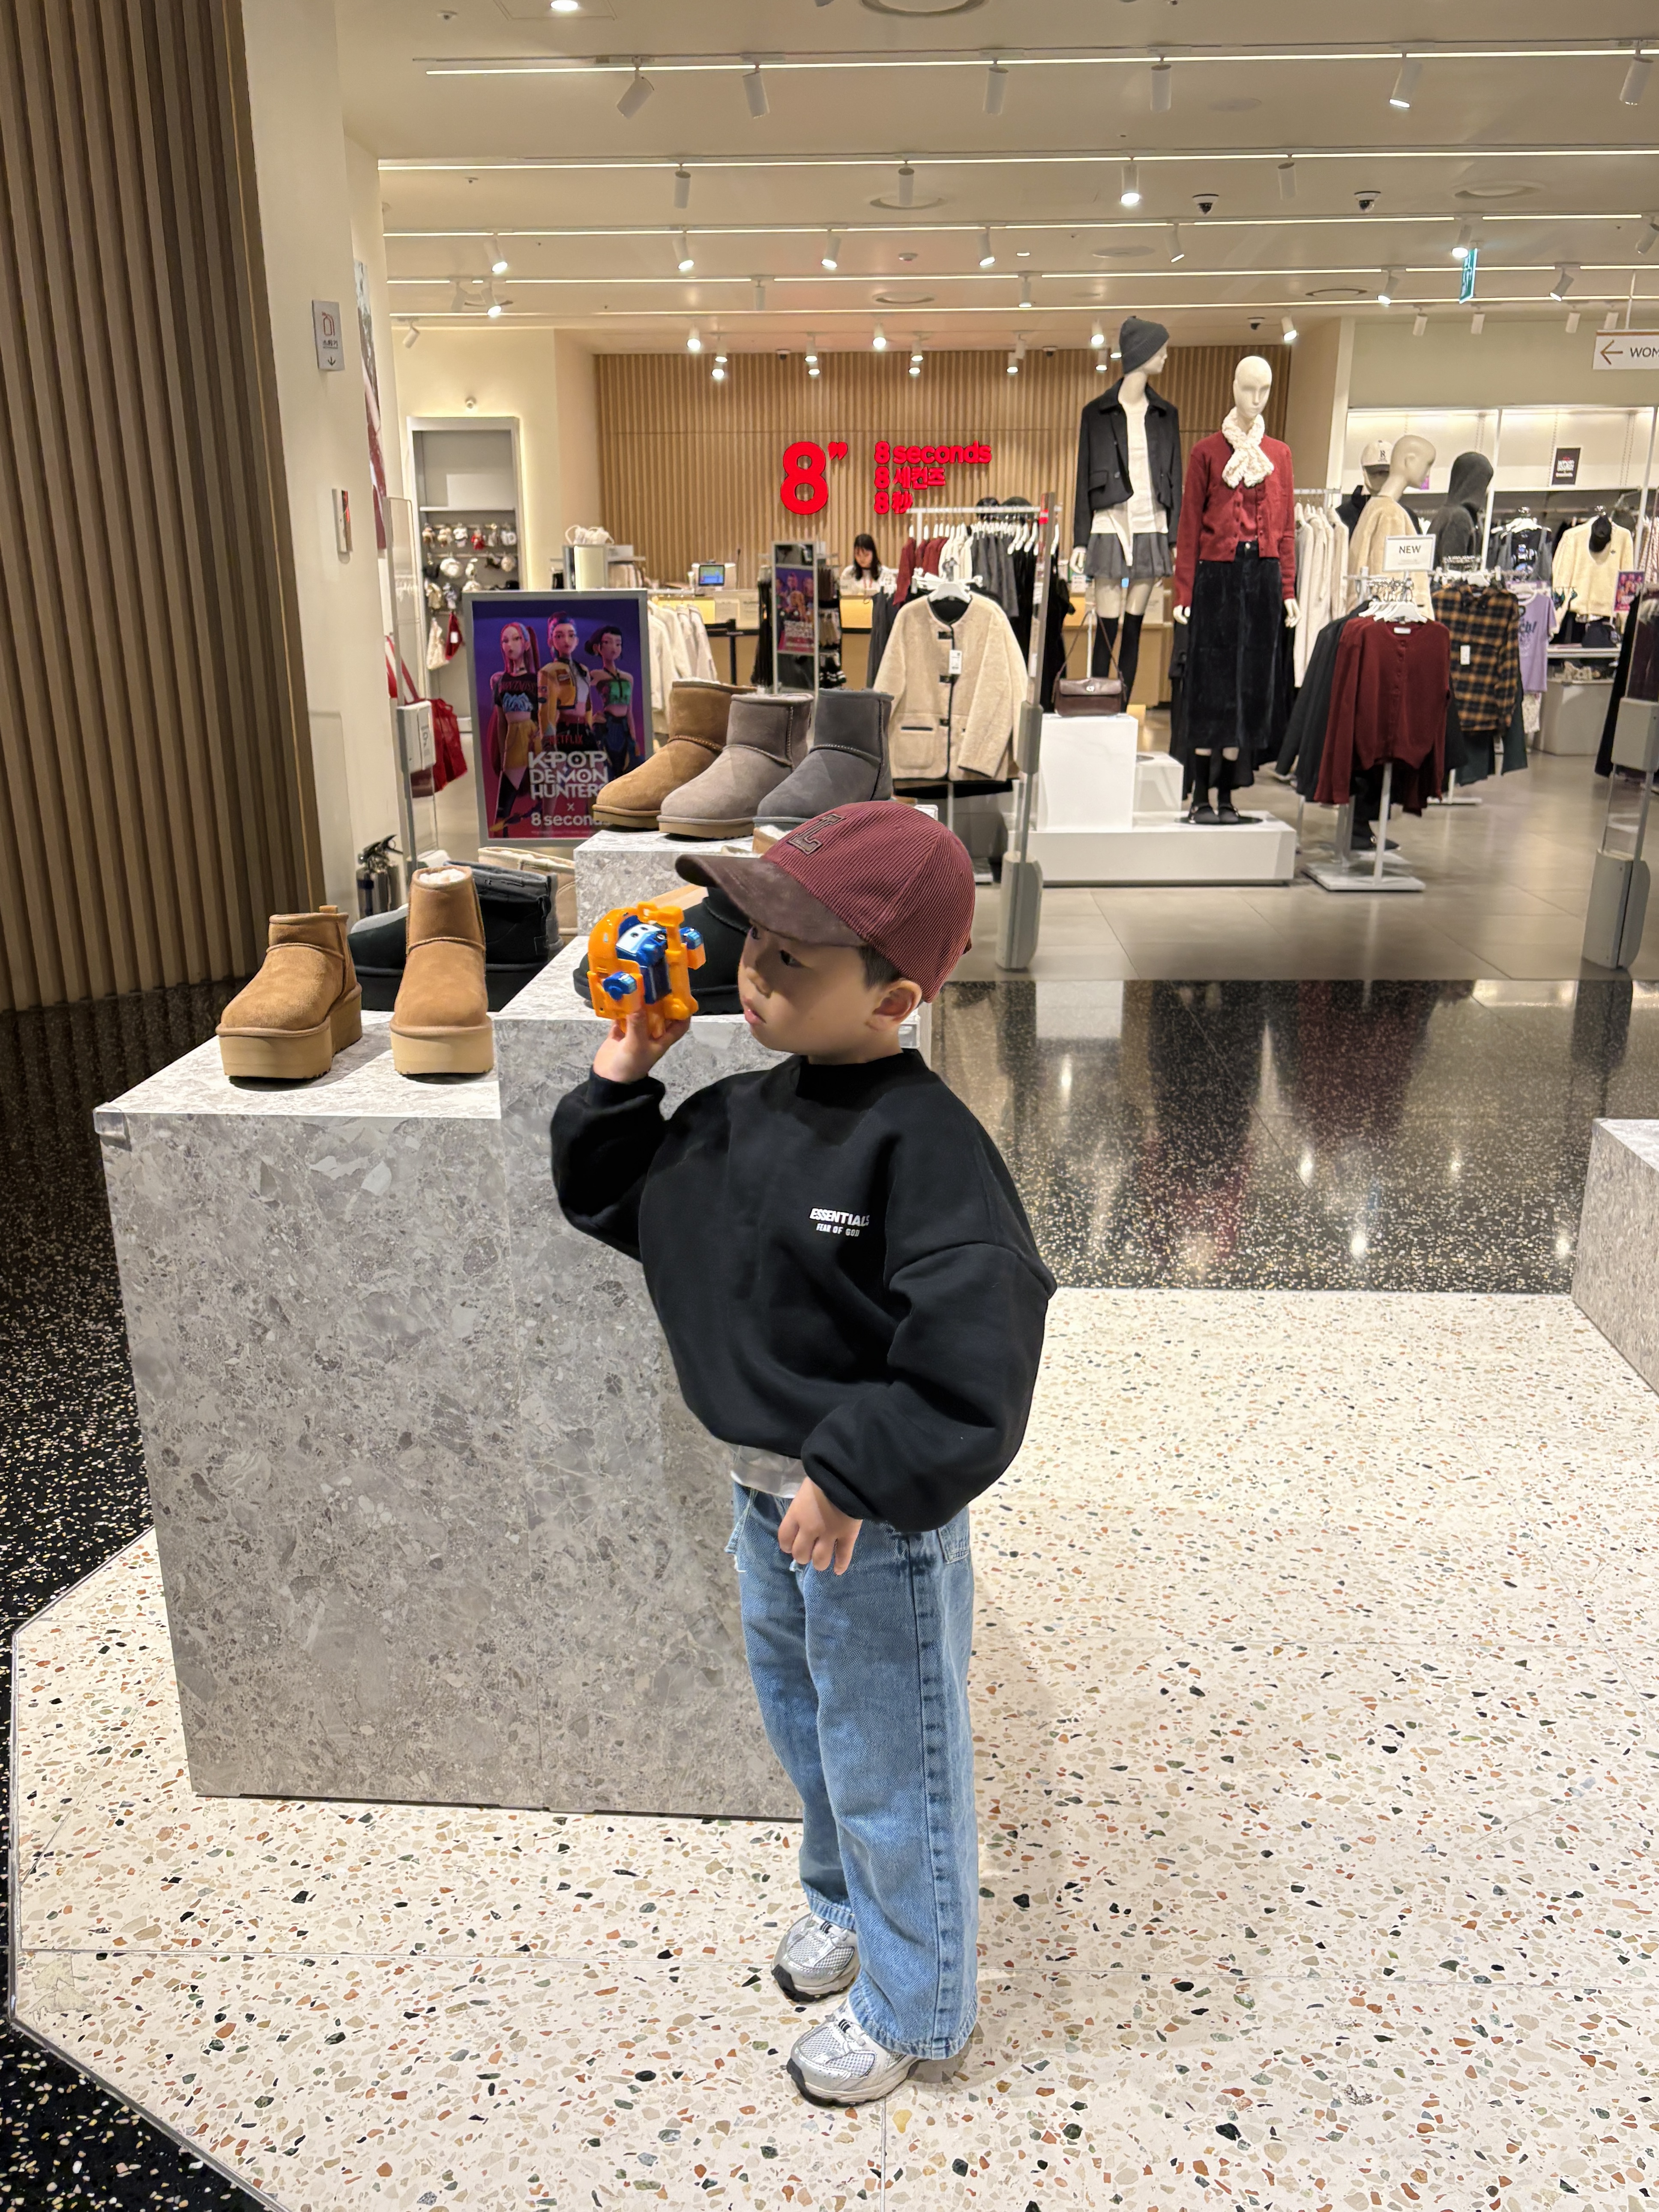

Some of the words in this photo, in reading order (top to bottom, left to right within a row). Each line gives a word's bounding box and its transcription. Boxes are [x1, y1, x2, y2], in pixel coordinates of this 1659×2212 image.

[1399, 545, 1421, 554] NEW
[529, 766, 609, 784] DEMON
[816, 1223, 831, 1232] FEAR
[832, 1226, 843, 1234] OF
[845, 1228, 860, 1237] GOD
